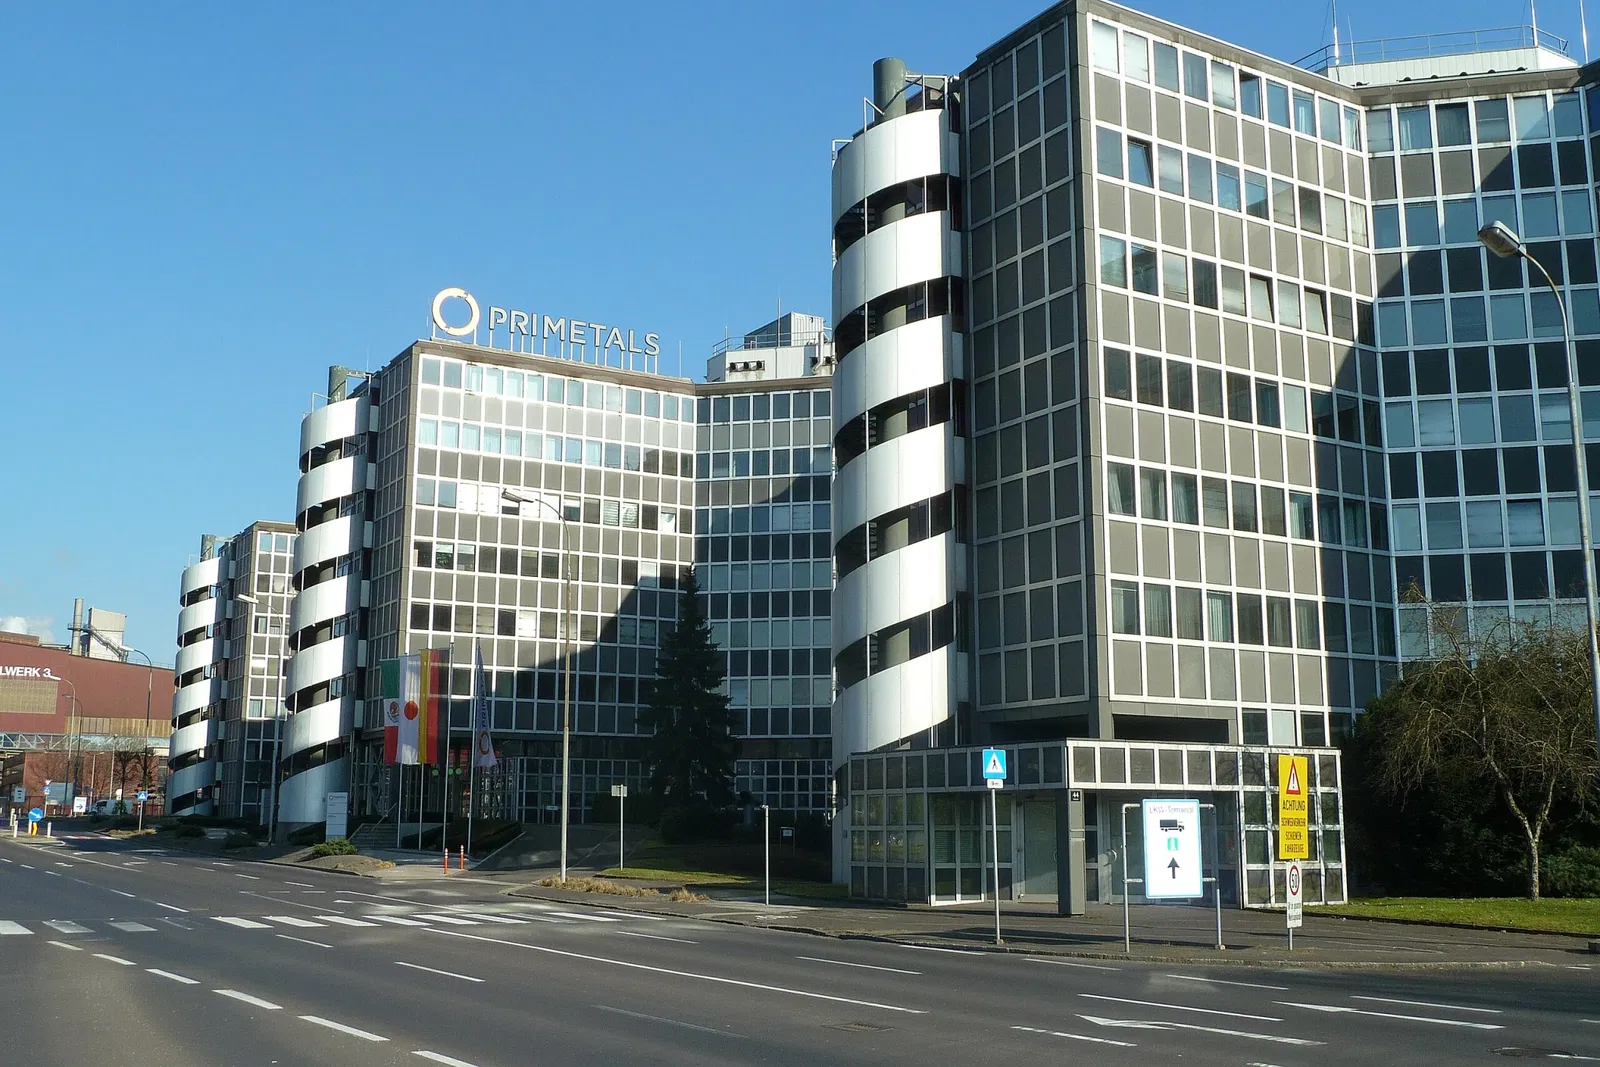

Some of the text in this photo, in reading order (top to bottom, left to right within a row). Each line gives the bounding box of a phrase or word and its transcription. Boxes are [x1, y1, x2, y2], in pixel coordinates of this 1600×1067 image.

[489, 306, 660, 356] PRIMETALS
[43, 668, 51, 677] 3
[1282, 800, 1306, 811] ACHTUNG
[1281, 817, 1306, 826] SCHWERVER
[1292, 873, 1298, 888] 50
